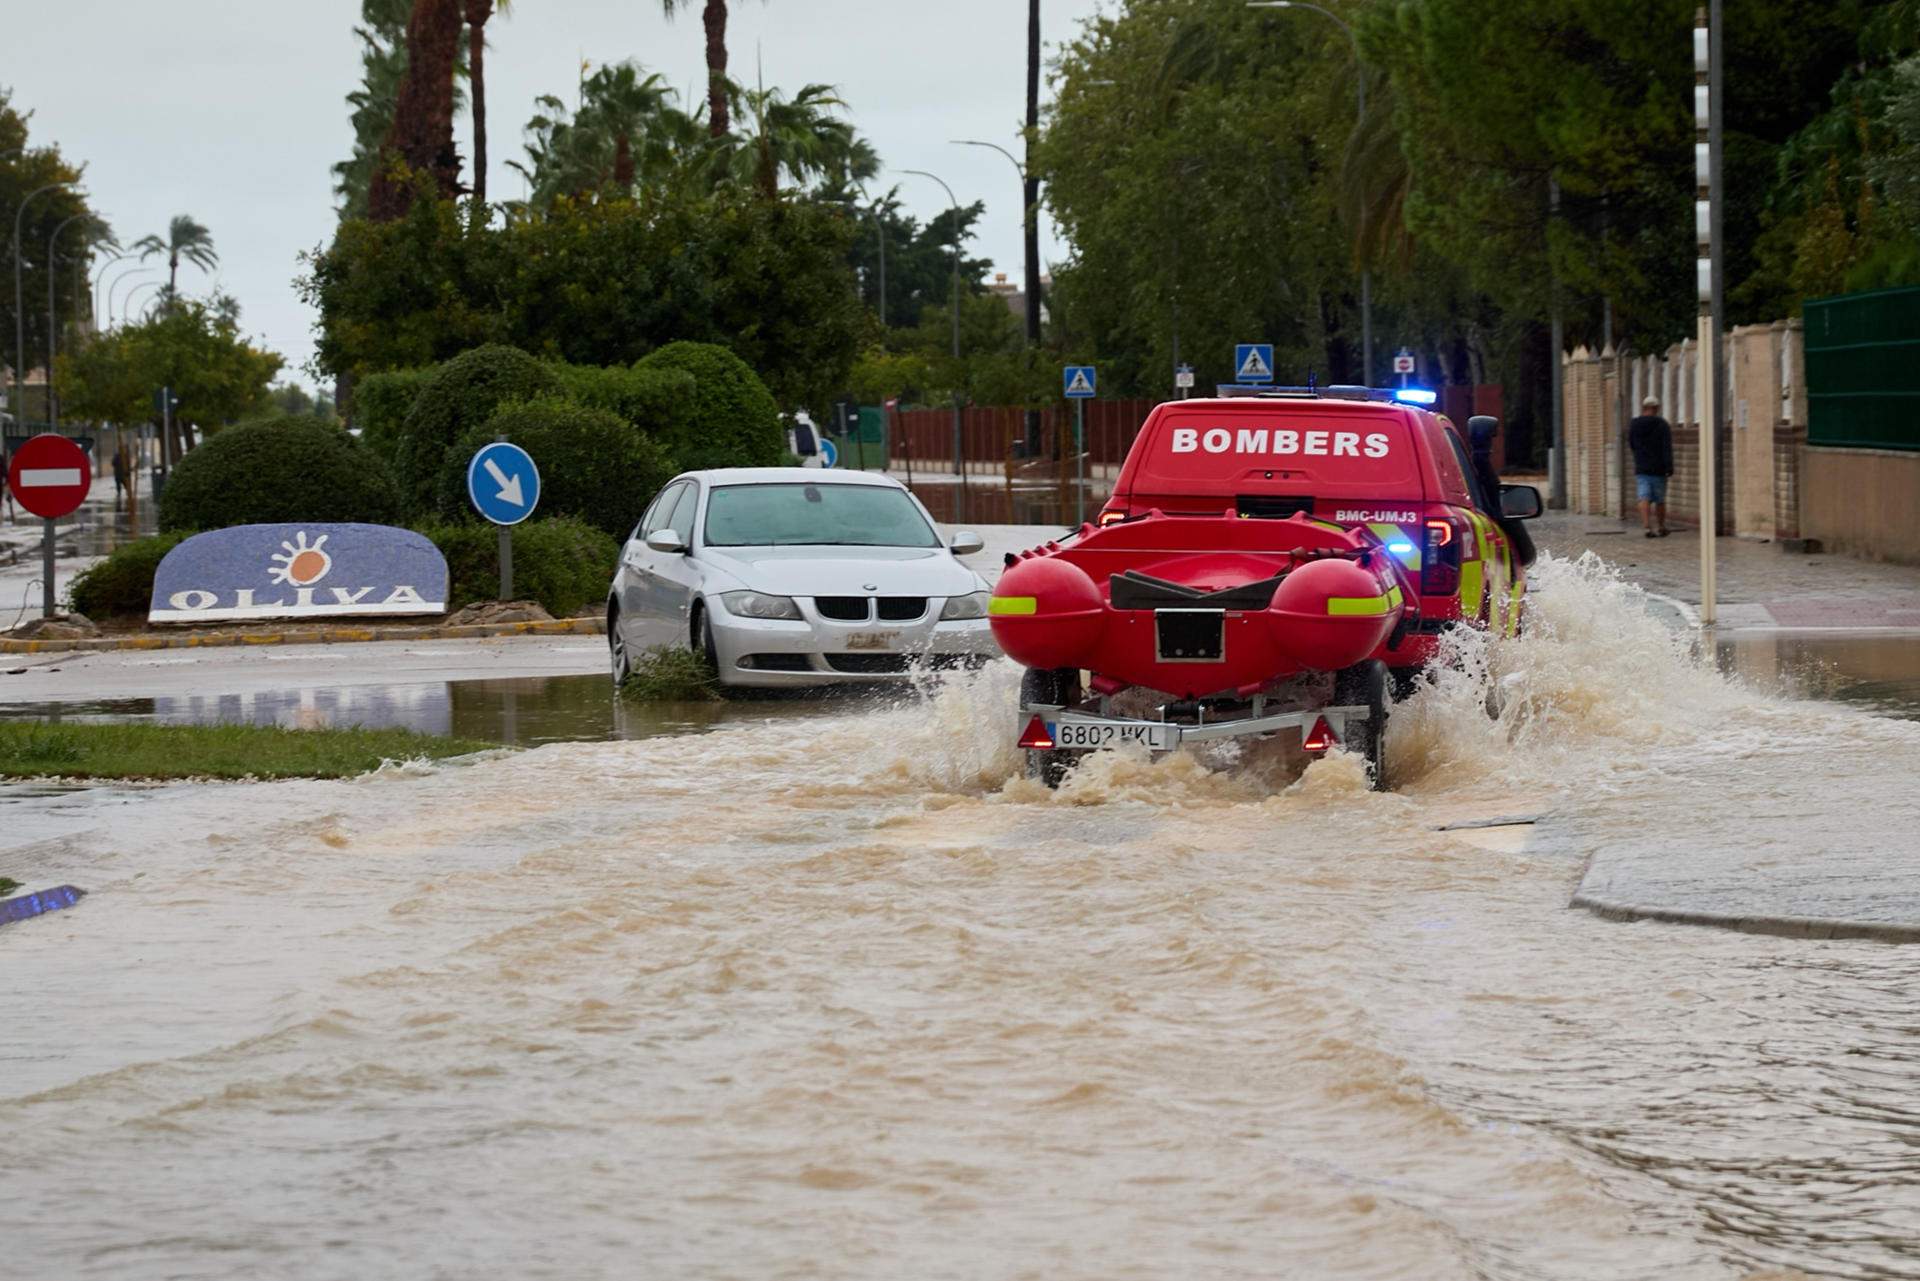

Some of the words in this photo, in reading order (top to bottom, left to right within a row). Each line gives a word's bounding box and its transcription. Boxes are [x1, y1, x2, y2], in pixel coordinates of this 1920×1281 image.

[1171, 428, 1390, 459] BOMBERS
[1335, 509, 1418, 524] BMC-UMJ3
[168, 585, 426, 610] OLIVA
[1060, 725, 1115, 746] 6802
